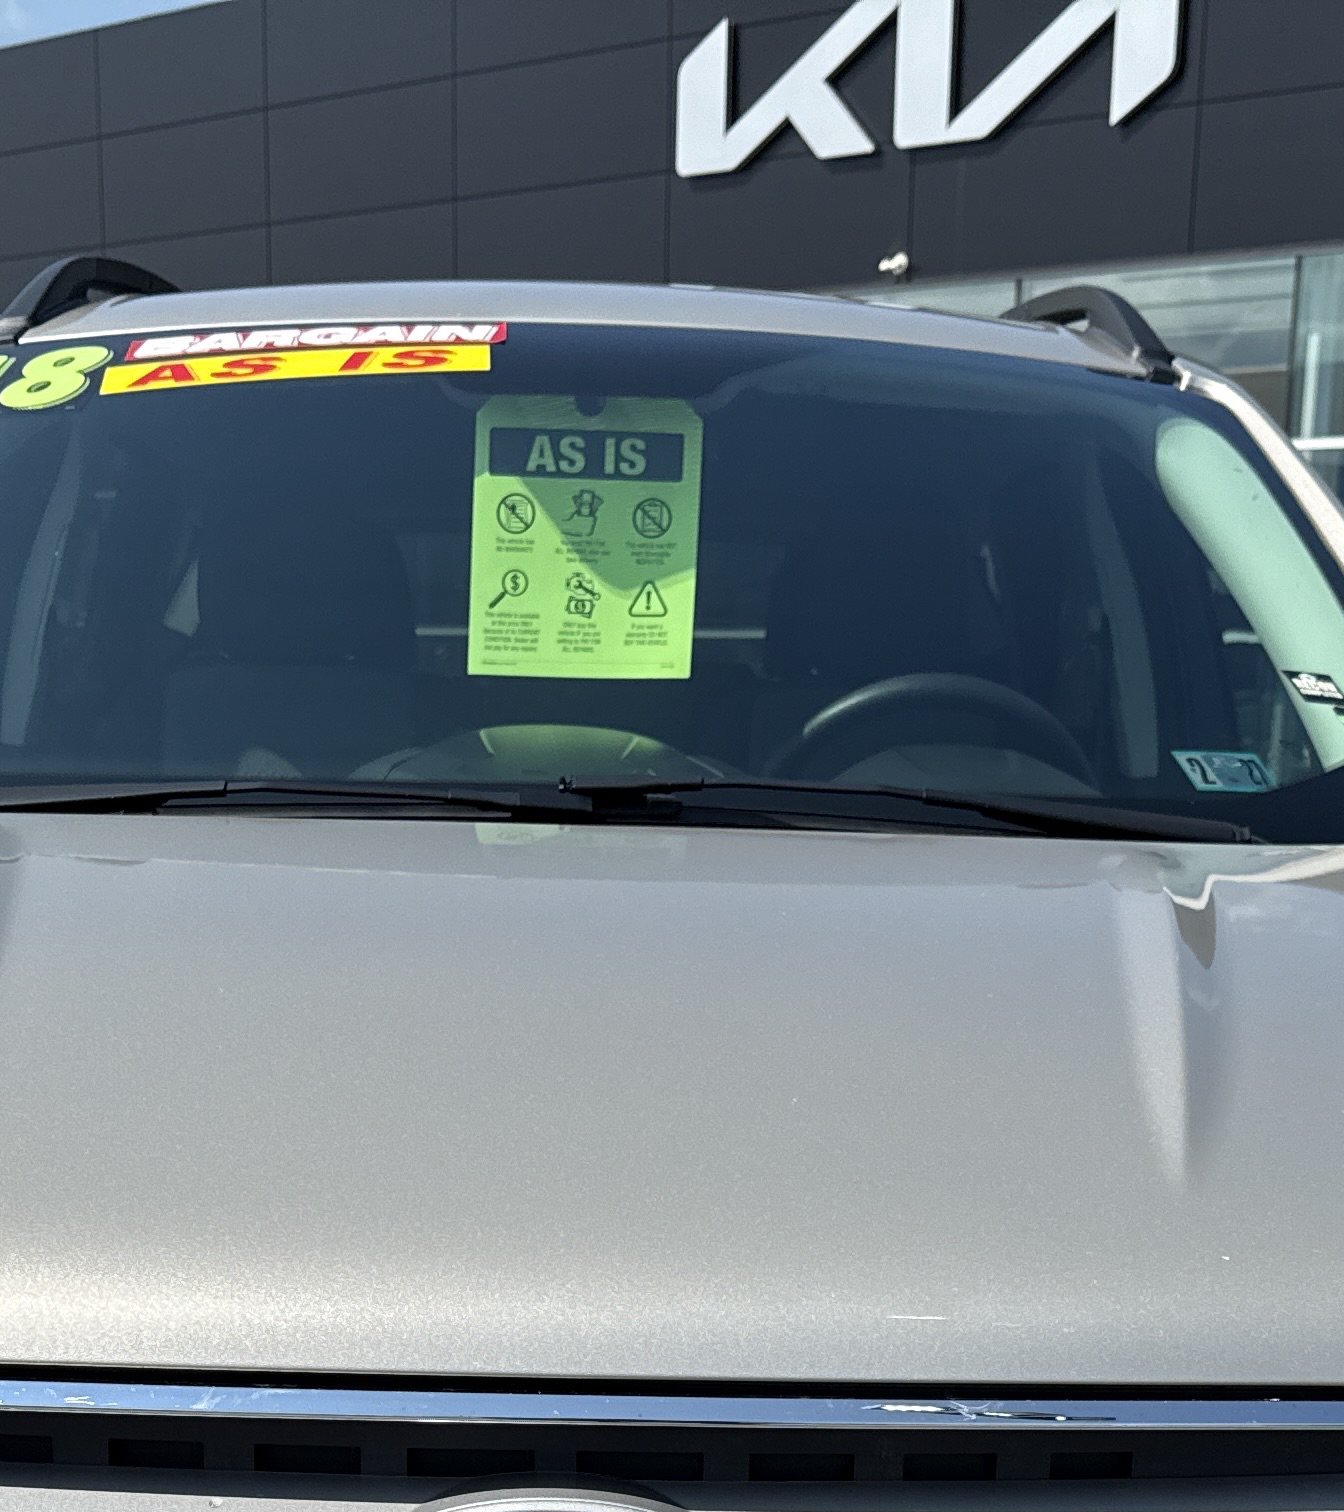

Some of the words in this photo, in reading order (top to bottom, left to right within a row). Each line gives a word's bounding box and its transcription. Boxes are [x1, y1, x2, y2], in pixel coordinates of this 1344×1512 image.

[132, 323, 498, 360] BARGAIN
[126, 356, 288, 388] AS
[338, 349, 459, 374] IS
[525, 434, 587, 475] AS
[603, 436, 647, 476] IS
